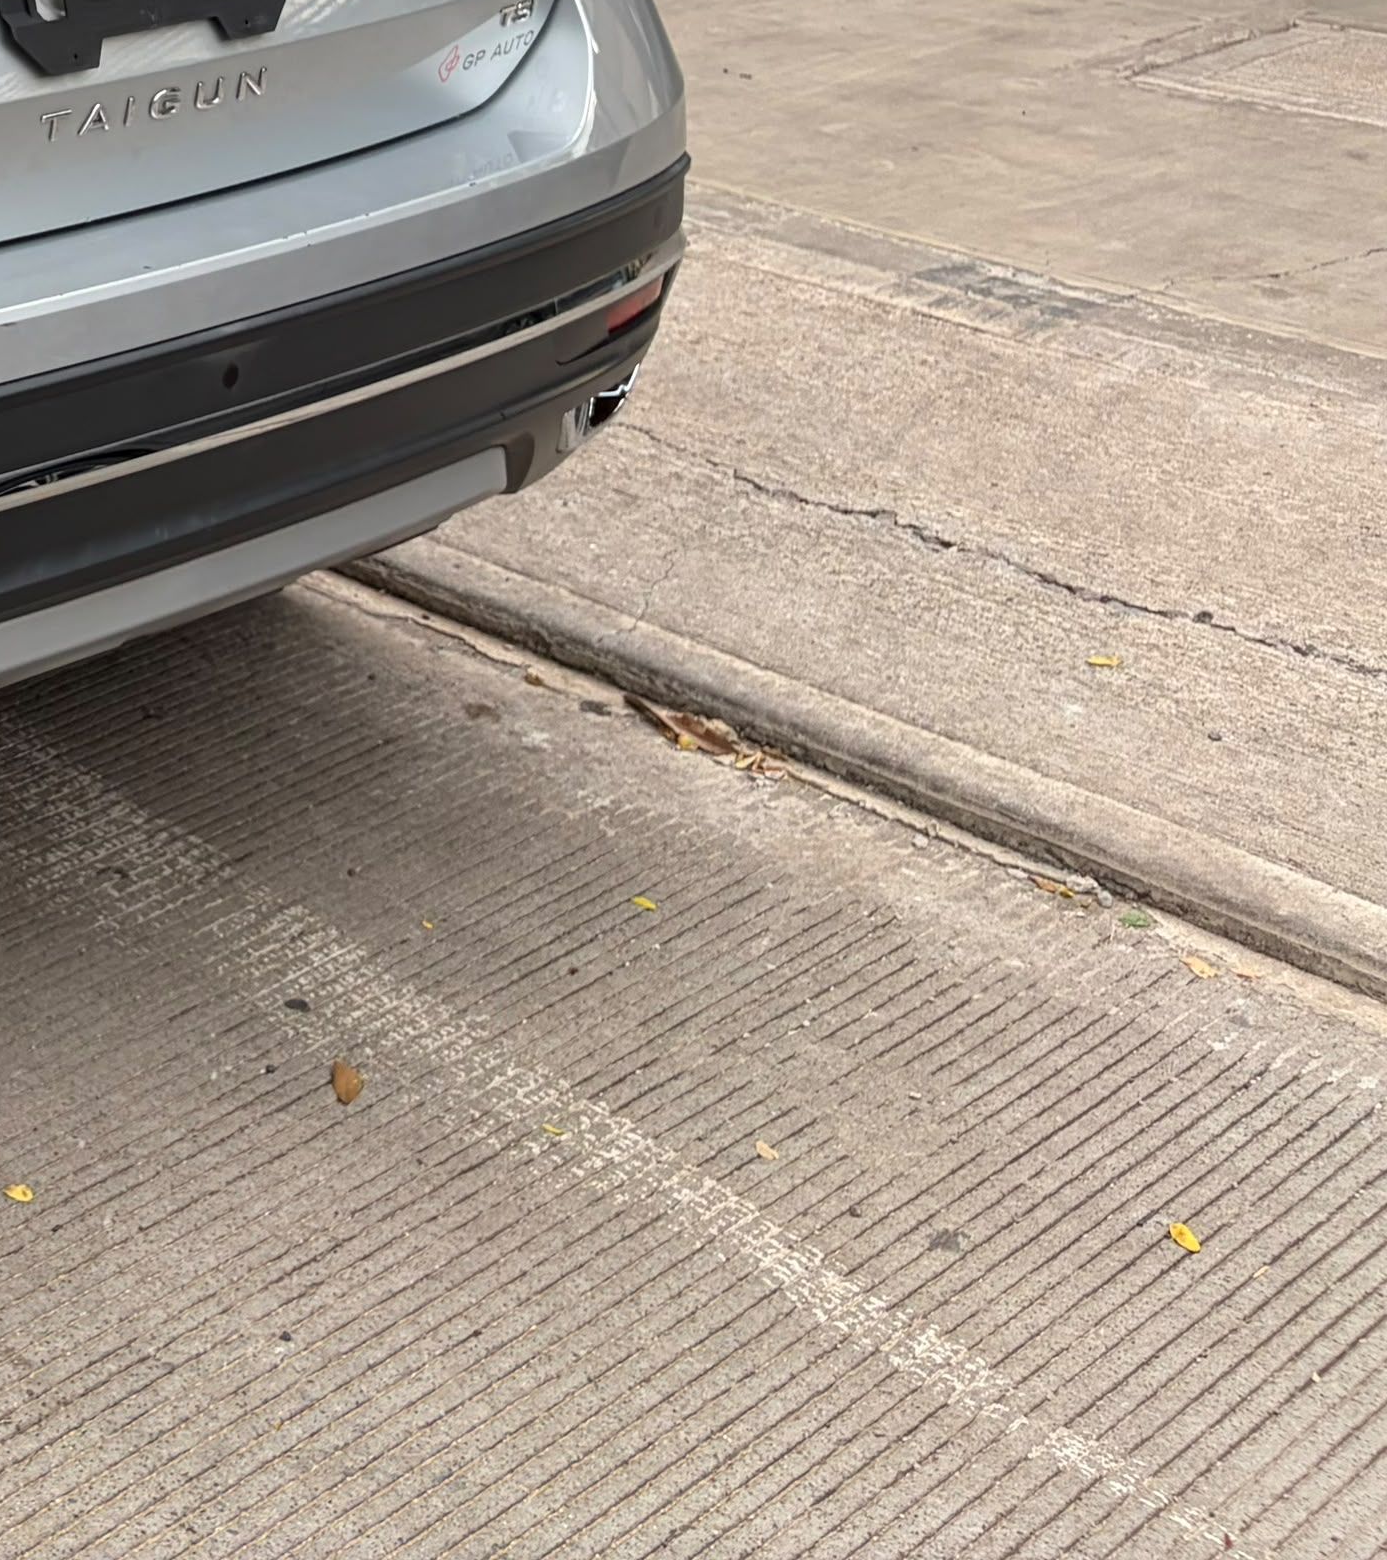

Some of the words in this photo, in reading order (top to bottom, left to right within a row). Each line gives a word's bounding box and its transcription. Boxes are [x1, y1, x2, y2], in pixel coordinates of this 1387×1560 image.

[462, 49, 486, 71] GP
[490, 30, 535, 61] AUTO
[40, 66, 268, 143] TAIGUN
